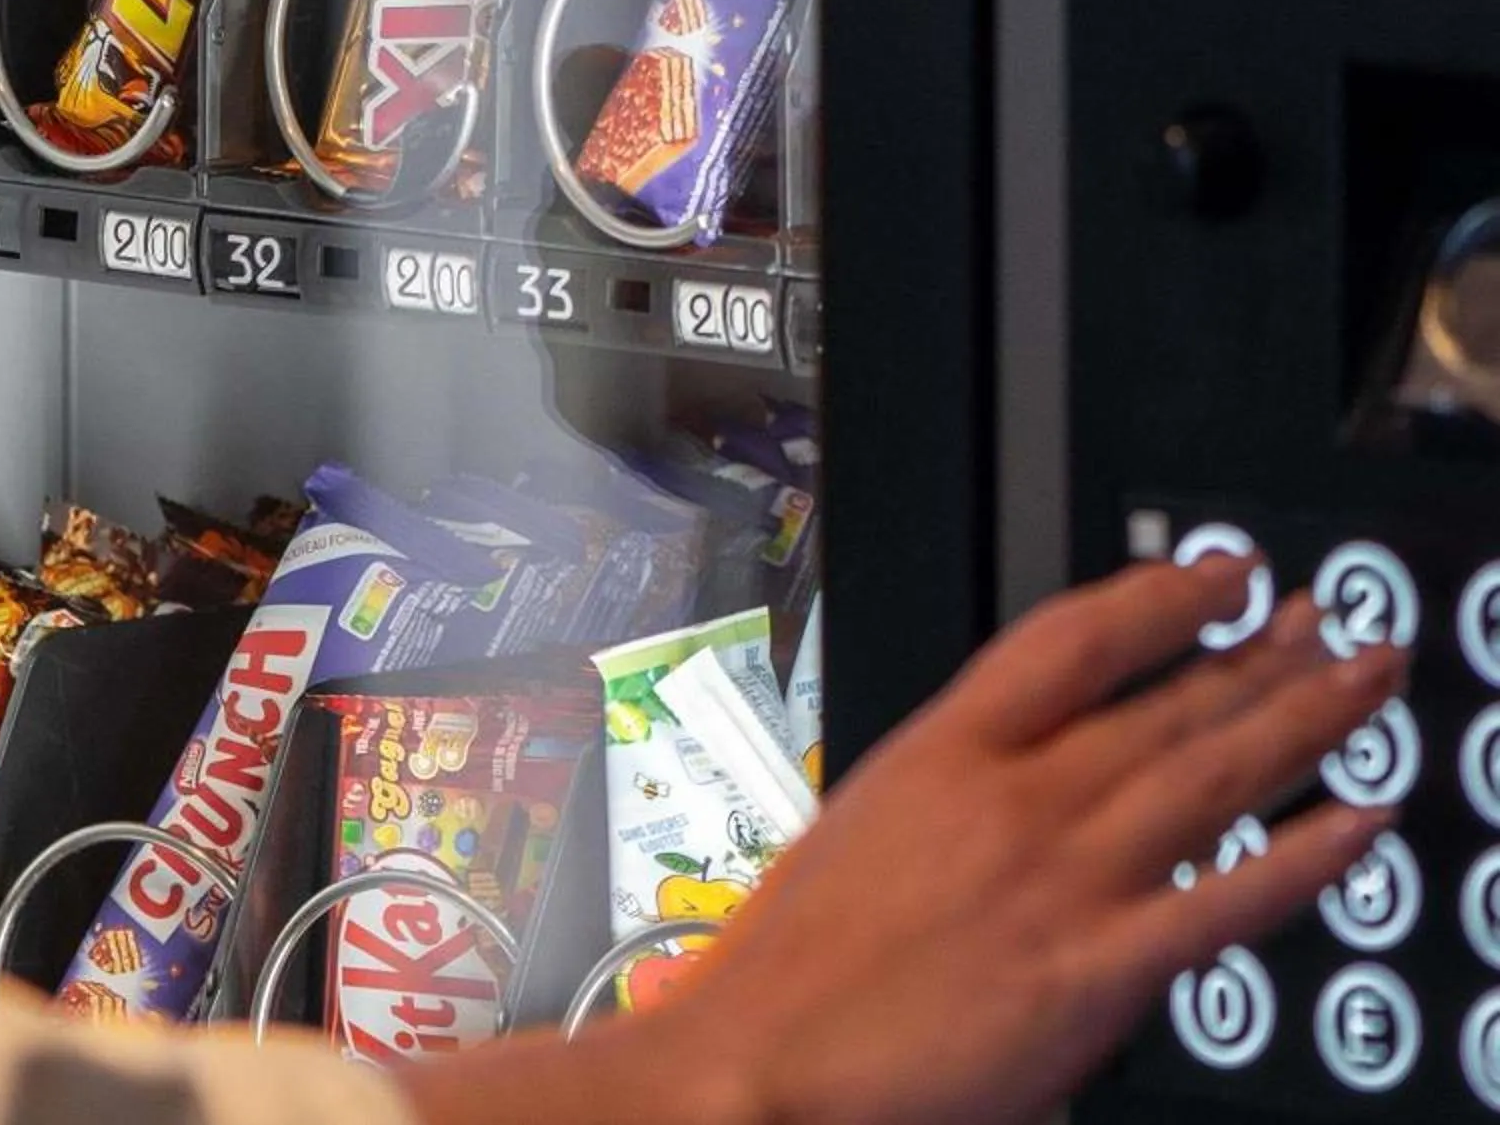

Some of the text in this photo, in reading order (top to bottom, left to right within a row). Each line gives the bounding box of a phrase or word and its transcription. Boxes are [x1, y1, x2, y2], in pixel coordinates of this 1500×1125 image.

[227, 234, 285, 288] 32
[516, 265, 574, 320] 33
[128, 629, 308, 920] CRUNCH
